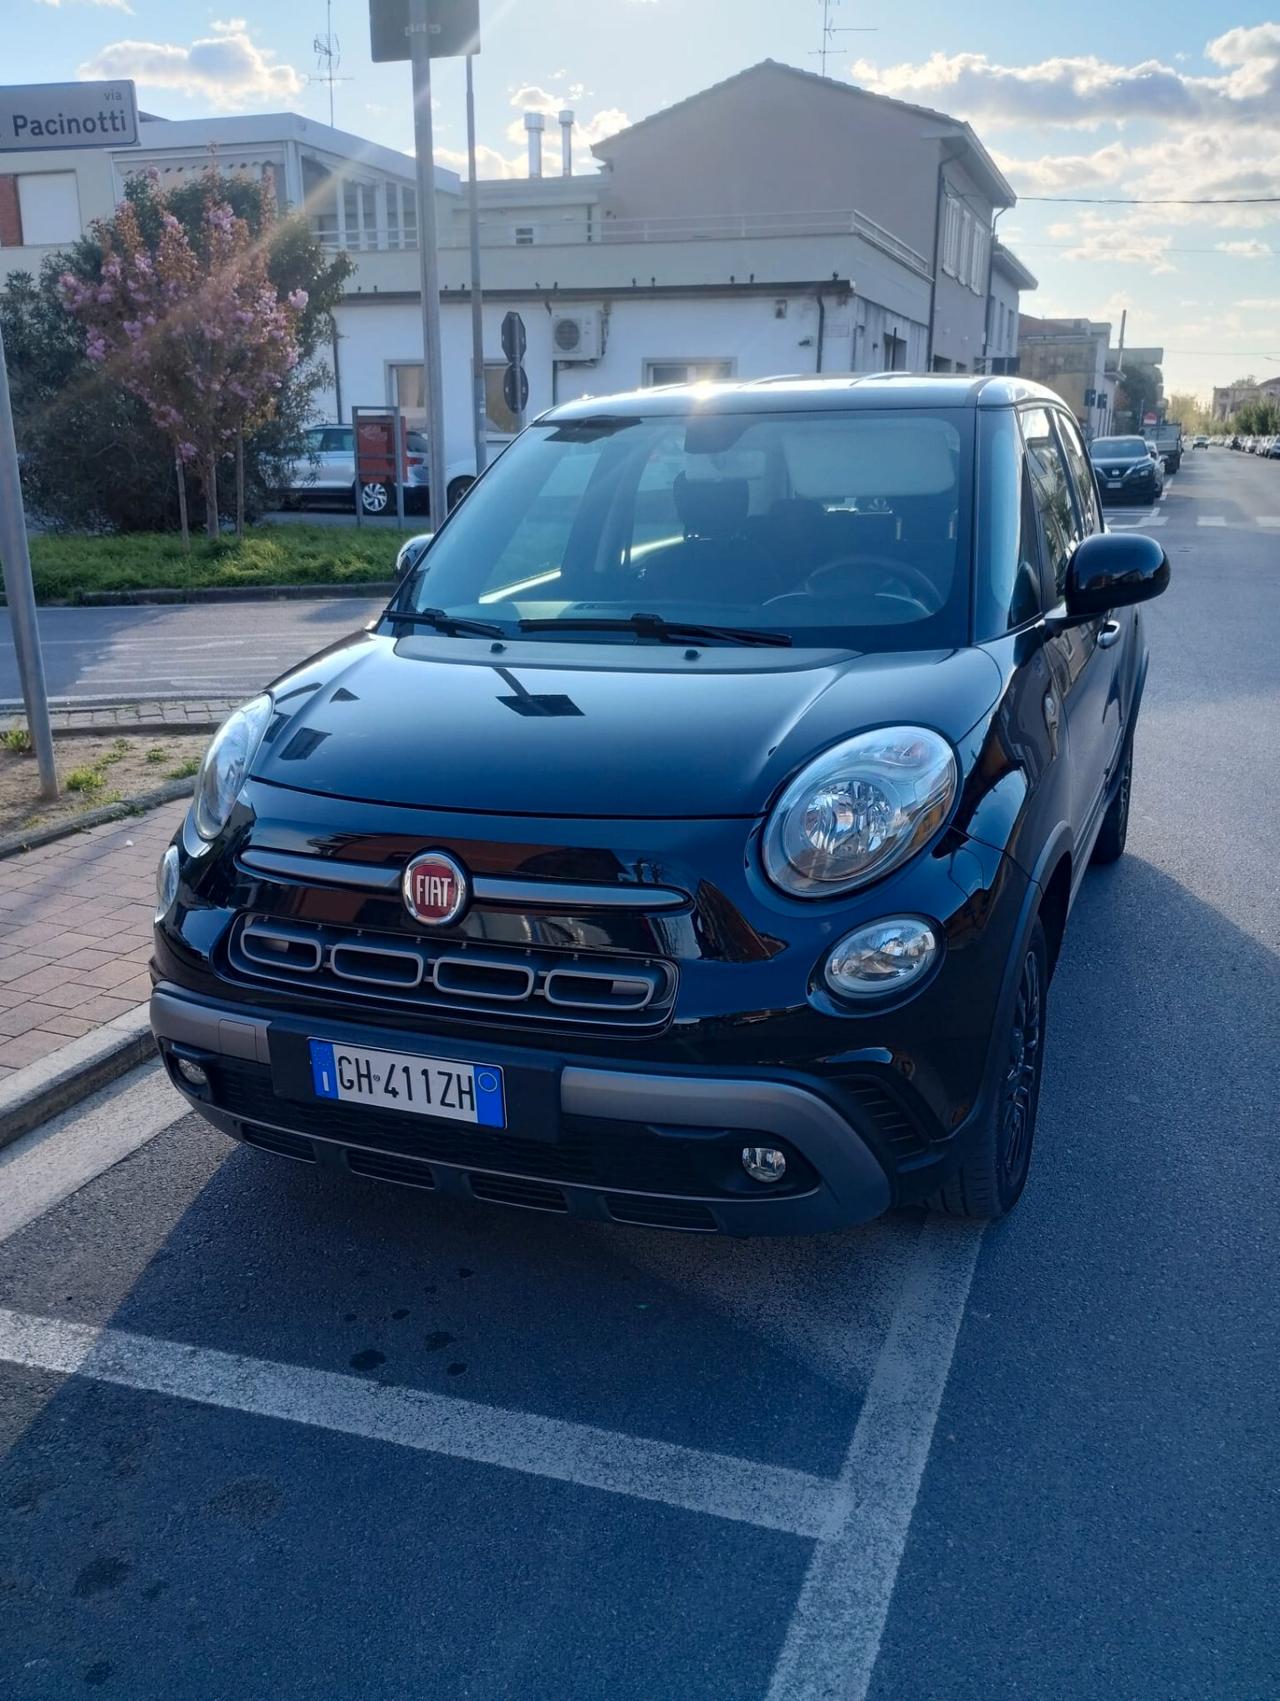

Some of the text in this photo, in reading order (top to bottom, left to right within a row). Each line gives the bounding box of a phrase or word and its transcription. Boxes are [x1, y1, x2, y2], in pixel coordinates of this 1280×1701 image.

[104, 89, 122, 101] via
[12, 109, 127, 137] Pacinotti
[416, 874, 452, 907] FIAT
